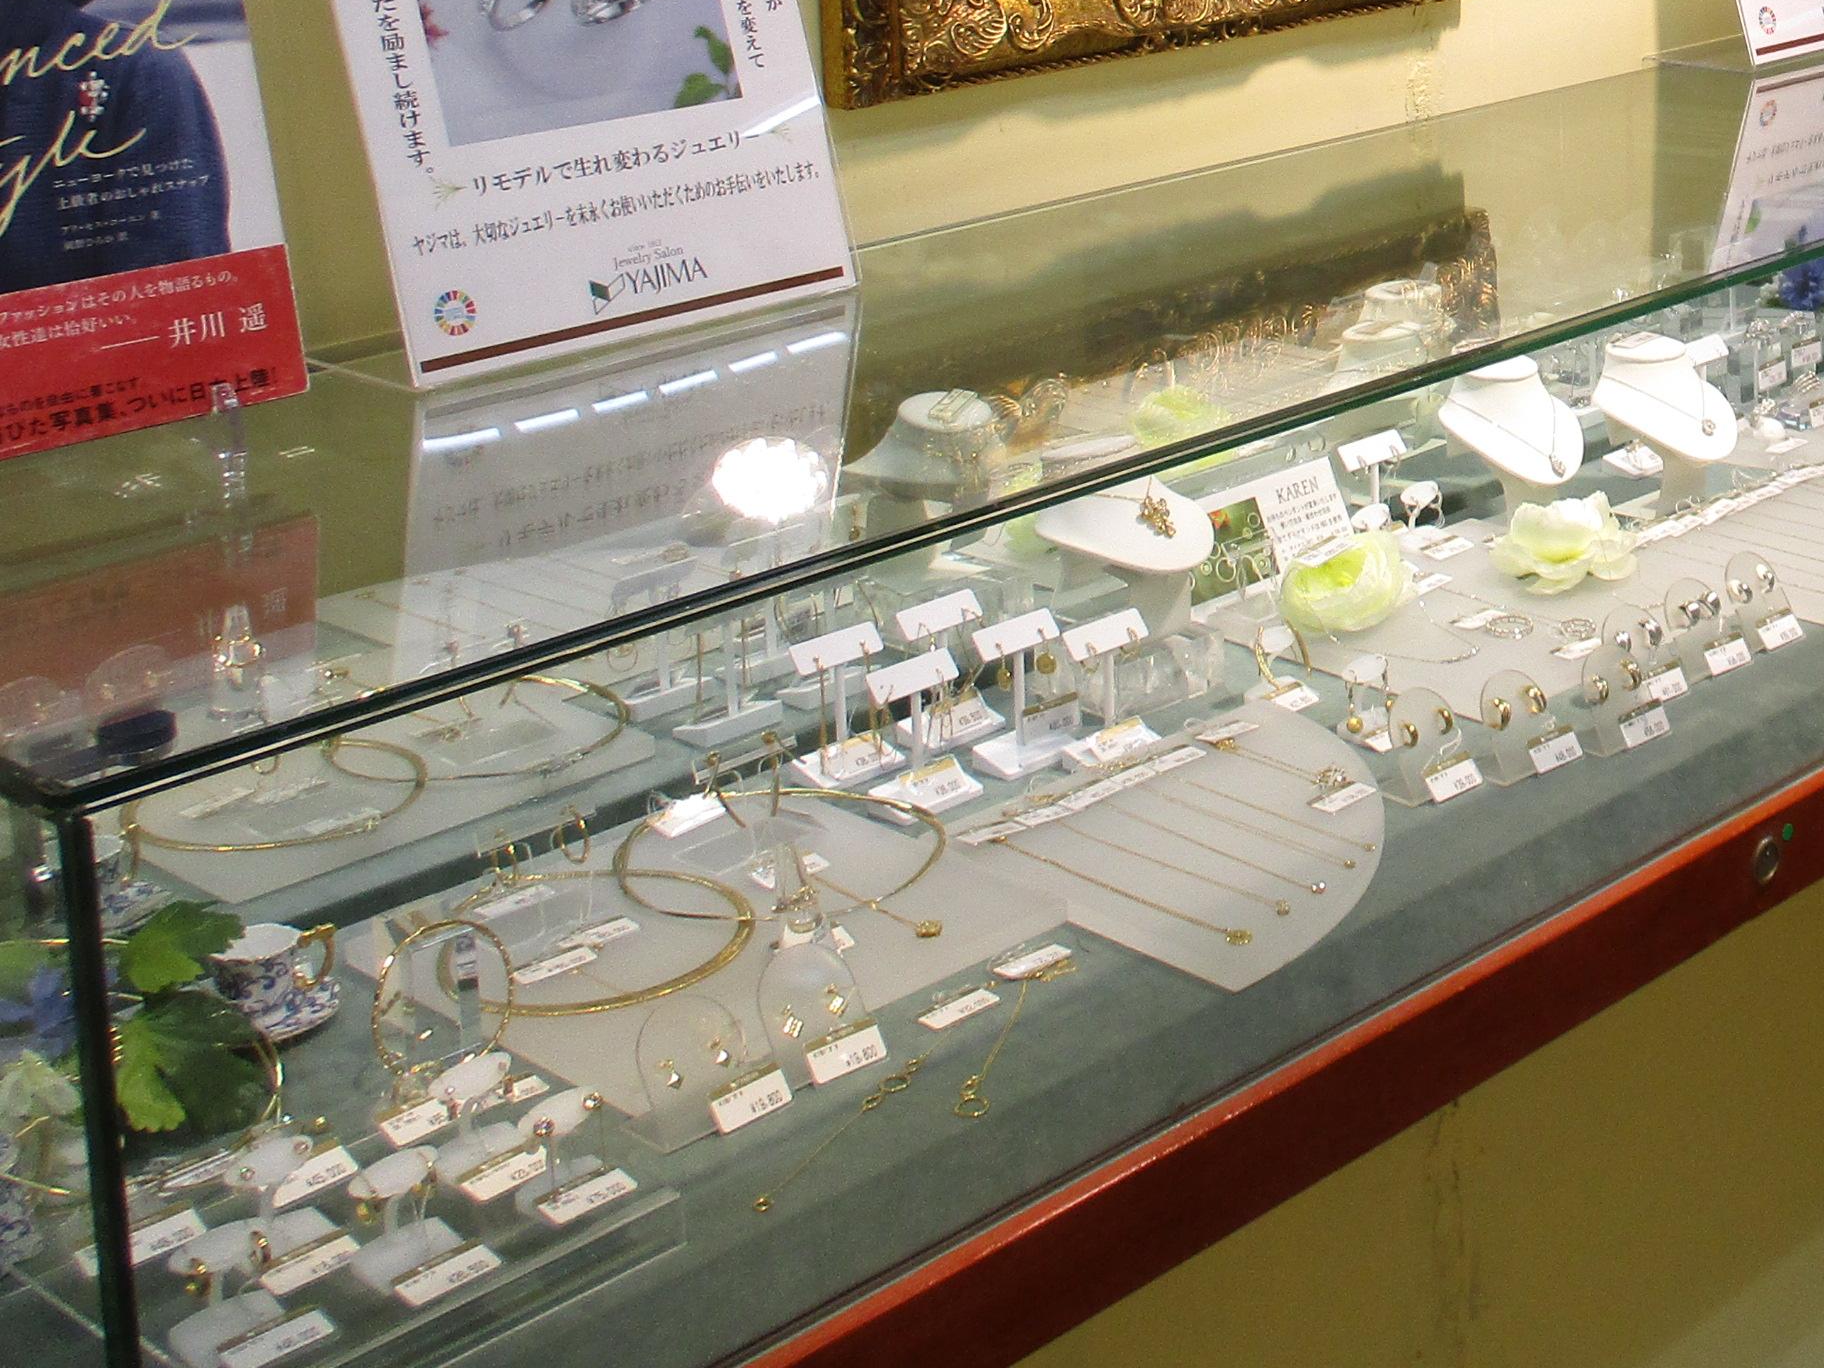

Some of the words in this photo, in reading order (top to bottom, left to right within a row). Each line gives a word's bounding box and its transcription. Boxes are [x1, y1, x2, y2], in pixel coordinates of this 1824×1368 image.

[472, 131, 761, 195] リモデルで生れ変わるジュエリー
[654, 245, 685, 261] Salon
[625, 256, 709, 295] YAJIMA
[168, 311, 226, 349] 井川
[1275, 475, 1320, 505] KAREN
